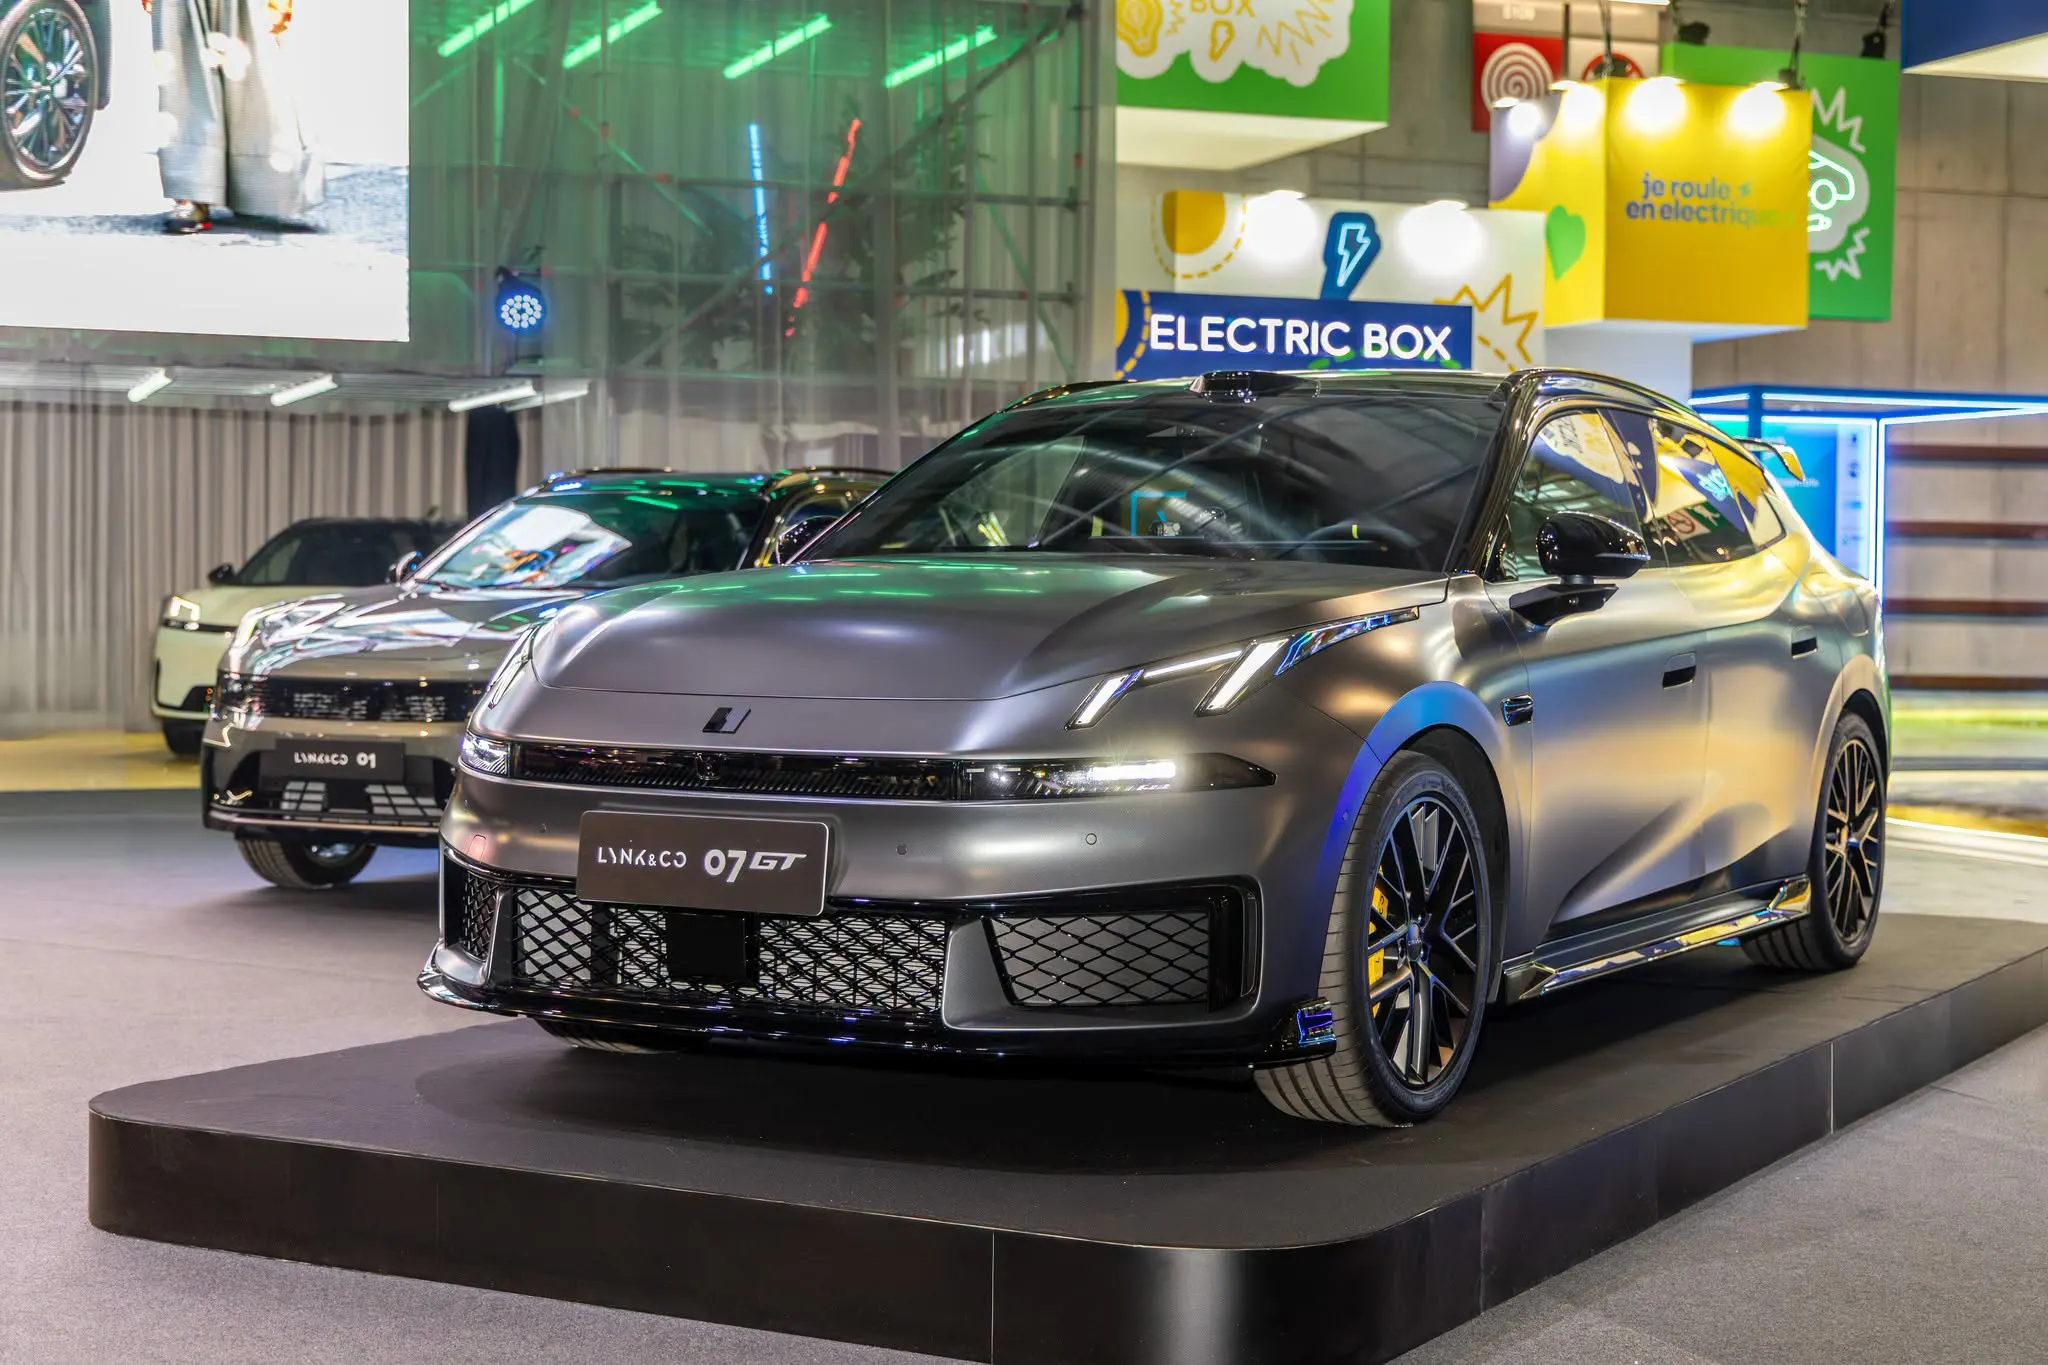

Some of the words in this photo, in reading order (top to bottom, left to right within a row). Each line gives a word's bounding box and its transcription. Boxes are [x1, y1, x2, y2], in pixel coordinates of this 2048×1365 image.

[1641, 172, 1665, 200] je
[1671, 177, 1732, 200] roule
[1625, 201, 1655, 219] en
[1150, 313, 1351, 357] ELECTRIC
[1363, 322, 1451, 361] BOX
[356, 752, 377, 769] 01
[597, 846, 687, 868] LYNK&CO
